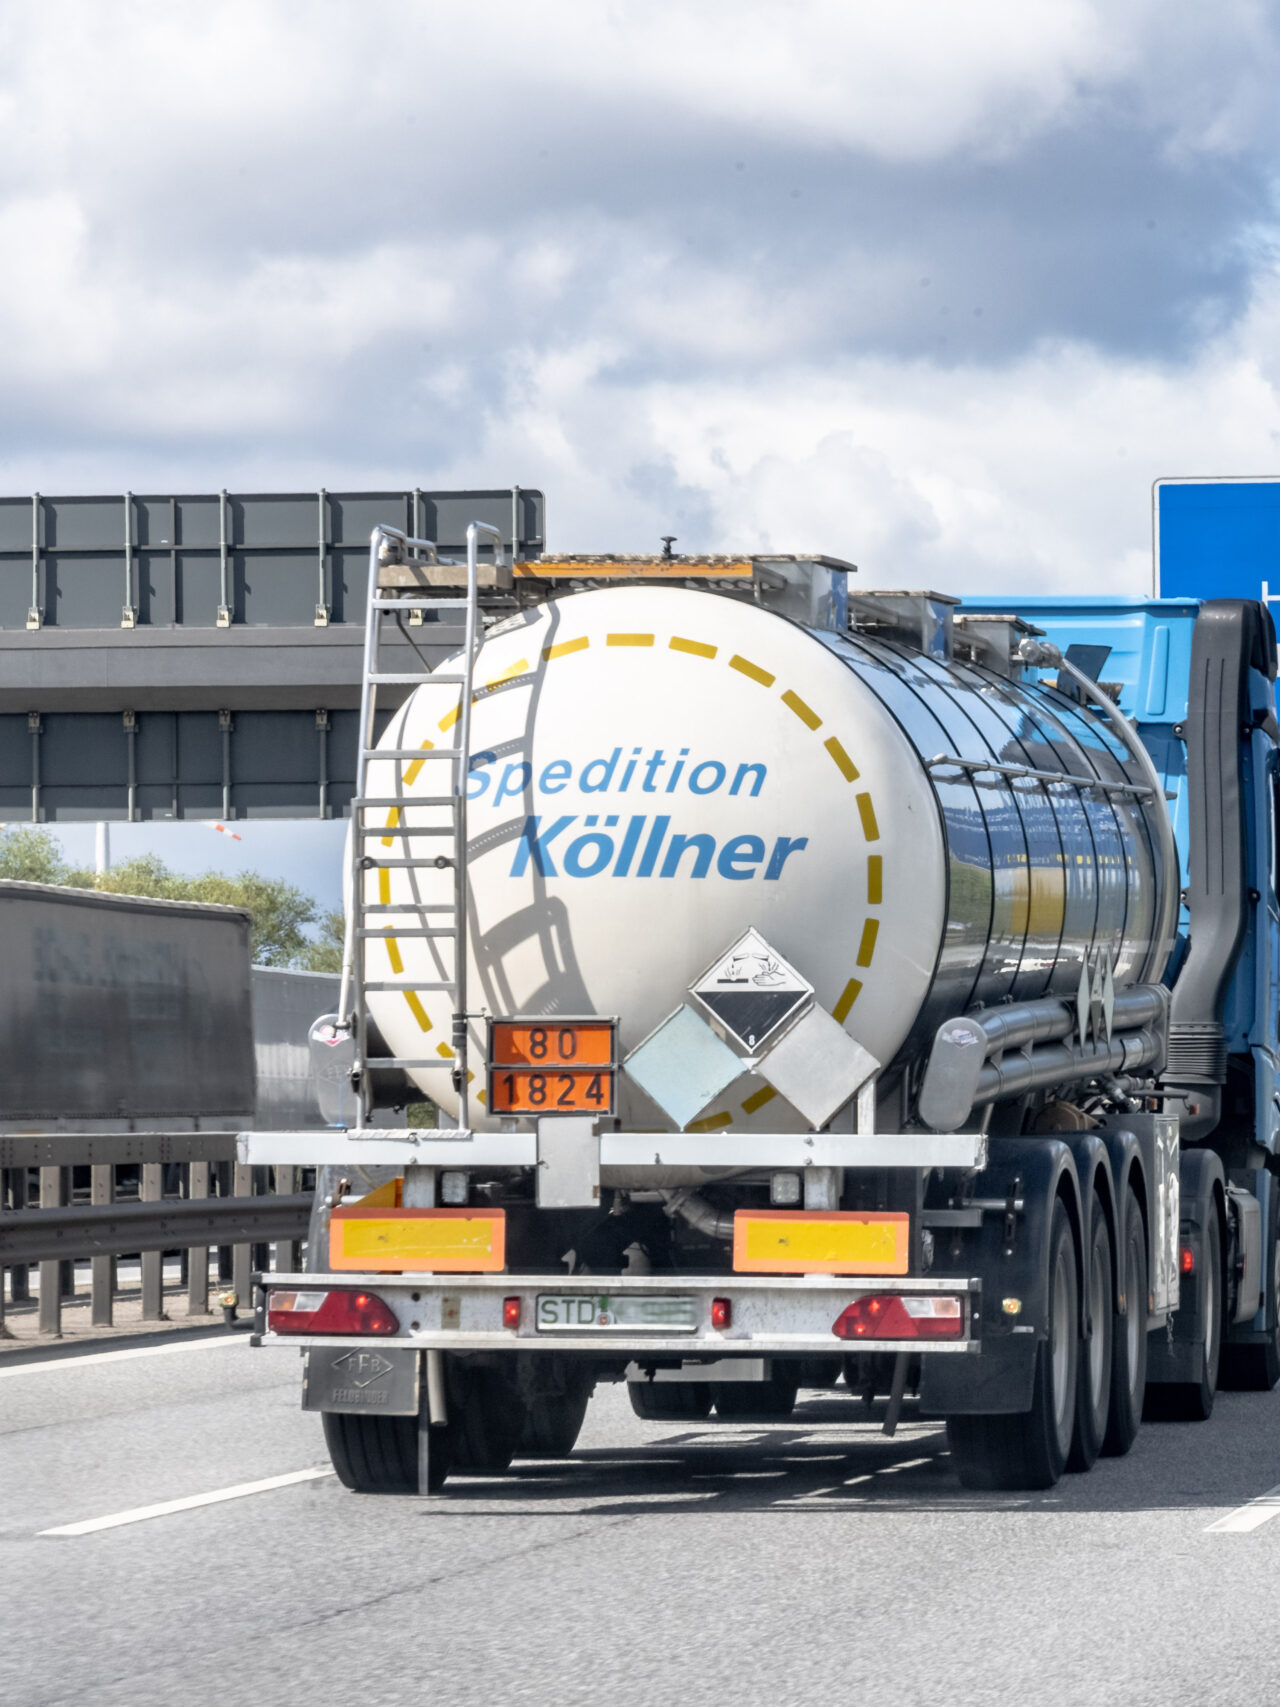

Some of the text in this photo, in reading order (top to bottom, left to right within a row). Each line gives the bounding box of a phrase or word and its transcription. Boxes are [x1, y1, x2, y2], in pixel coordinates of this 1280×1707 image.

[466, 746, 768, 808] Spedition
[508, 814, 809, 881] Köllner
[529, 1027, 577, 1060] 80
[748, 1034, 756, 1046] 8
[503, 1073, 604, 1106] 1824
[541, 1299, 595, 1324] STD
